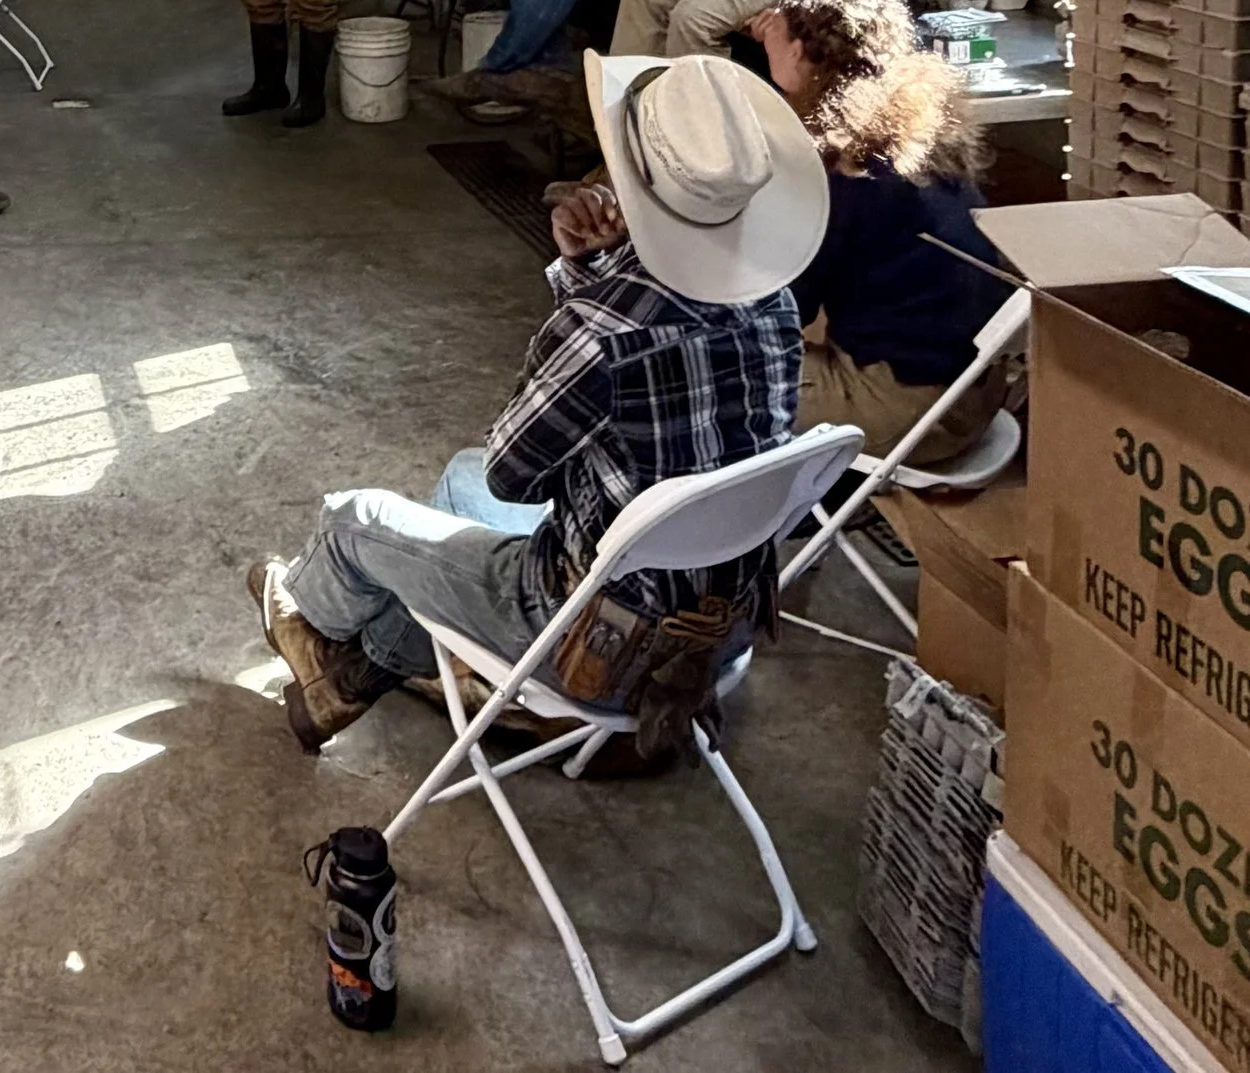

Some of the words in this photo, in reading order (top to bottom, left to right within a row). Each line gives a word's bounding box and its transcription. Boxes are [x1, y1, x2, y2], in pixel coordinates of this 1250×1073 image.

[1113, 427, 1164, 491] 30
[1179, 462, 1250, 550] DO
[1084, 557, 1146, 640] KEEP
[1091, 719, 1137, 789] 30
[1060, 839, 1117, 923] KEEP
